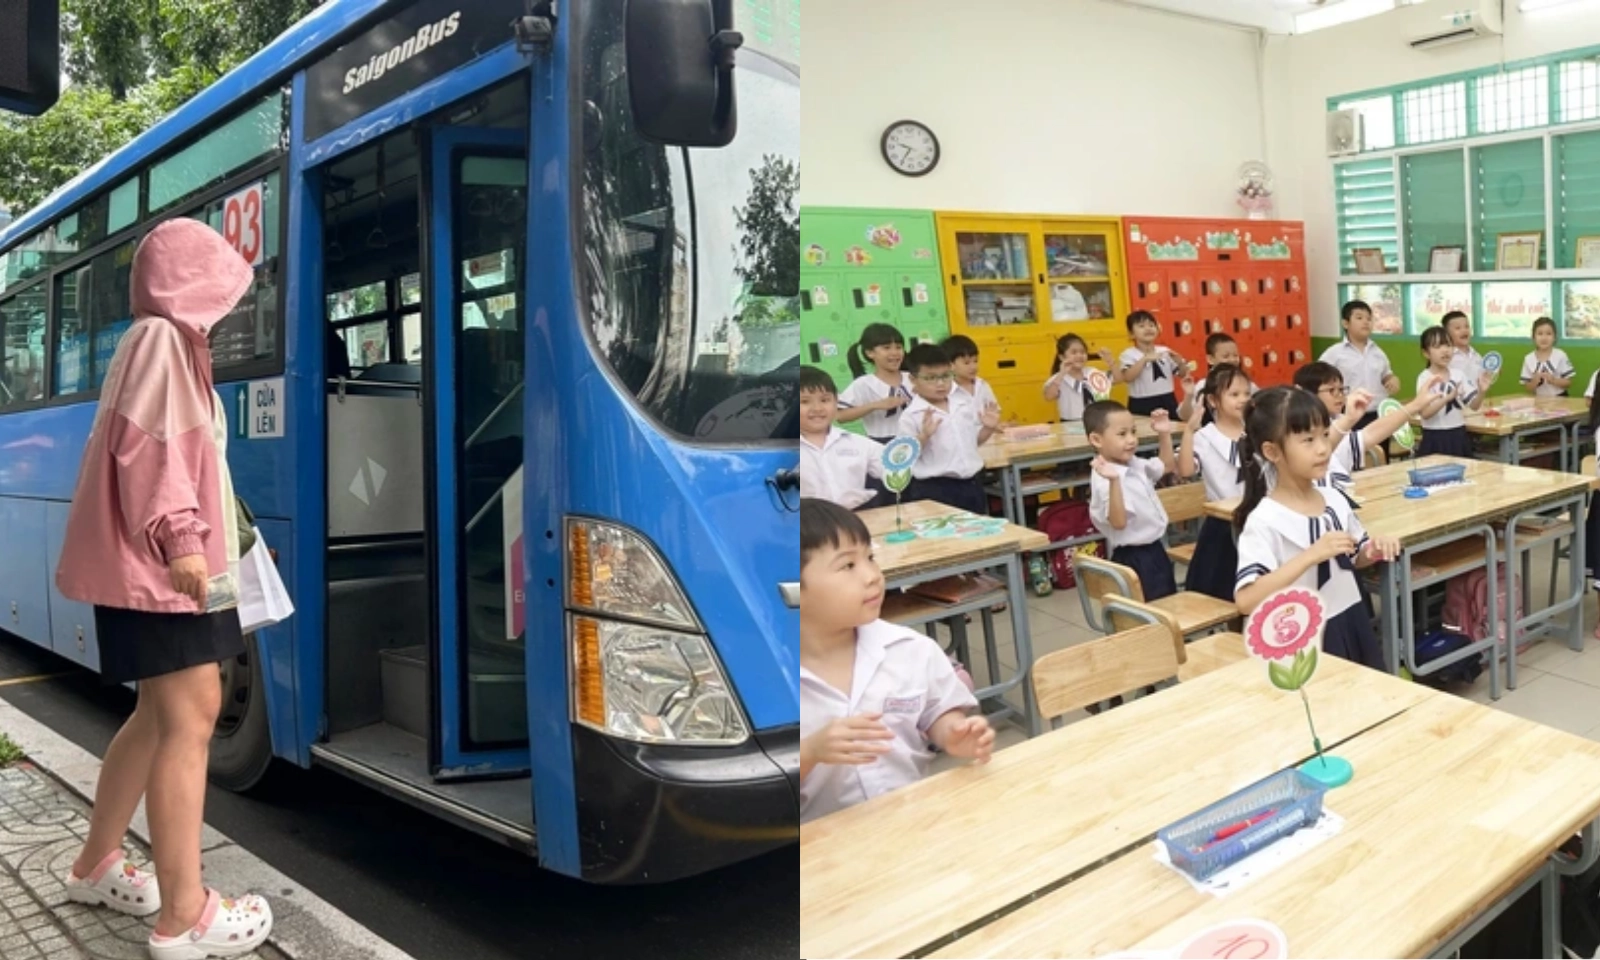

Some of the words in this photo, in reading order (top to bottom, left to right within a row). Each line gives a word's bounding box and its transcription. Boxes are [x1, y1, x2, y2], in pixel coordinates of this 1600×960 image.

[342, 10, 462, 94] SaigonBus
[224, 189, 260, 264] 93
[256, 382, 277, 408] CỬA
[256, 410, 276, 434] LÊN
[1272, 604, 1301, 645] 5
